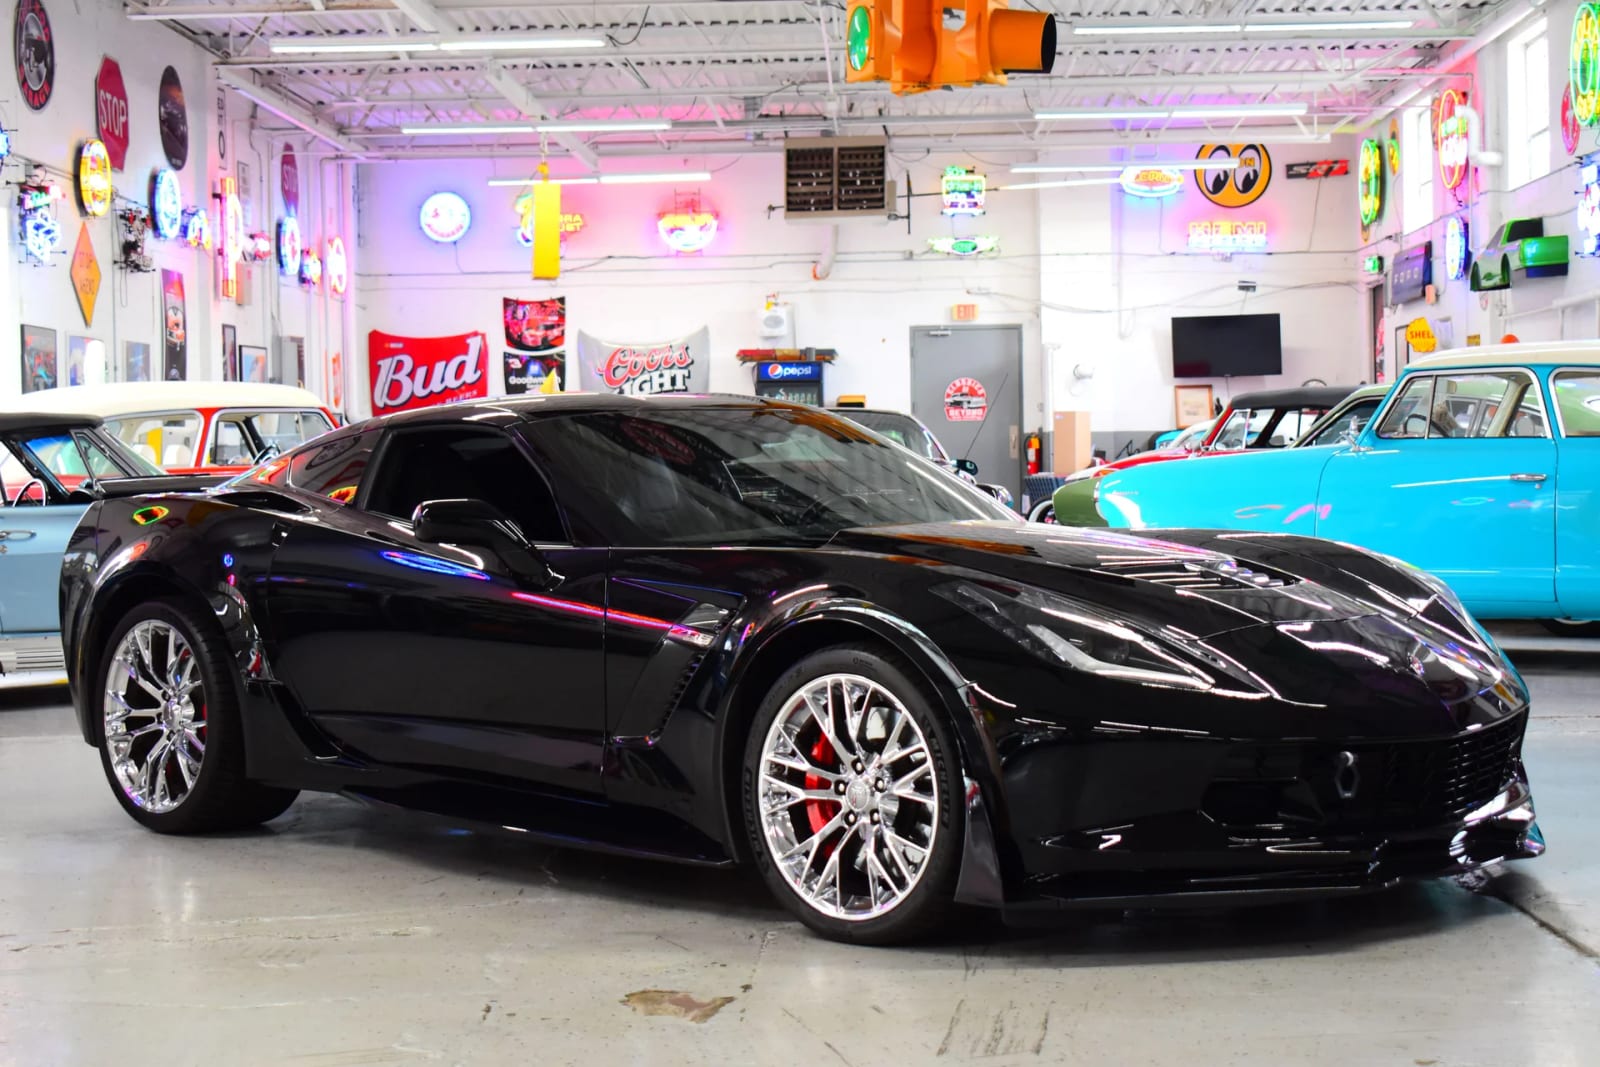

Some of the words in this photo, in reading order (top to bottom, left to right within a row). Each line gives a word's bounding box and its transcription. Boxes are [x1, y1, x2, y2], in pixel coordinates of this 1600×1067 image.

[99, 89, 127, 138] STOP
[957, 304, 976, 320] EXIT
[373, 336, 483, 410] Bud
[596, 345, 693, 389] Coors
[784, 366, 812, 377] pepsi
[949, 409, 983, 417] BEYOND
